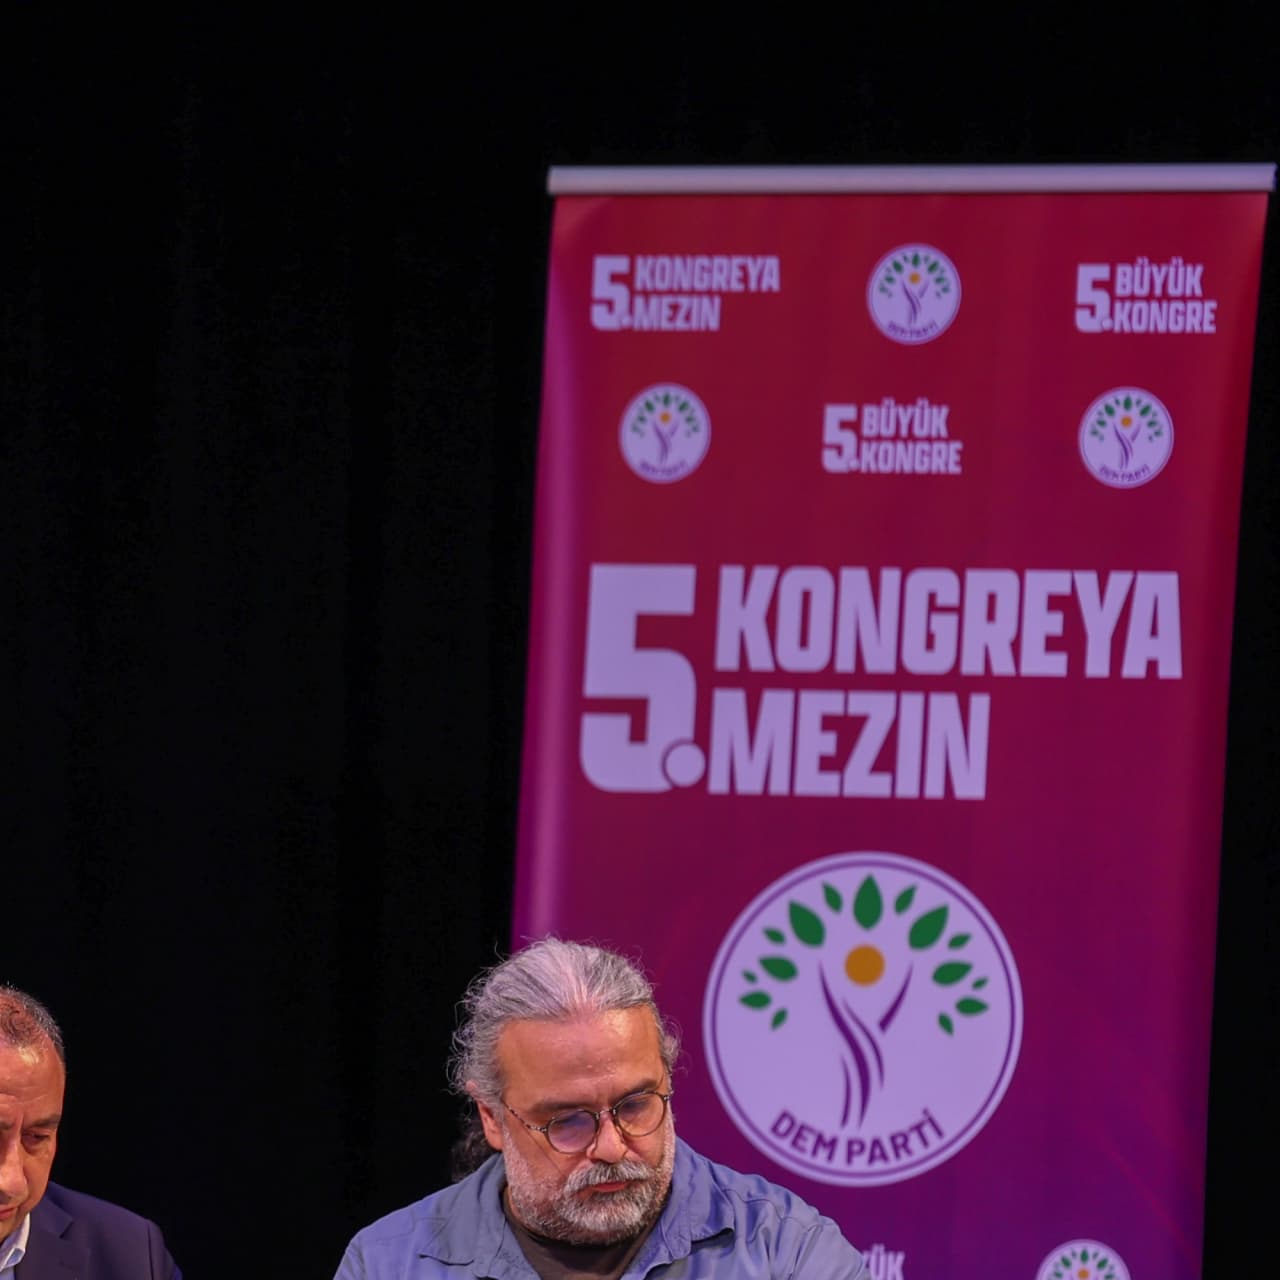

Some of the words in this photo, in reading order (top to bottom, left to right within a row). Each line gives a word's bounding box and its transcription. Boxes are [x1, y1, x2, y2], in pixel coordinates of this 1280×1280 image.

[591, 256, 633, 331] 5.
[634, 256, 780, 292] KONGREYA
[633, 295, 720, 331] MEZIN
[1076, 264, 1114, 333] 5.
[1115, 258, 1203, 297] BÜYÜK
[1114, 300, 1217, 333] KONGRE
[822, 405, 860, 473] 5.
[861, 399, 949, 438] BÜYÜK
[860, 441, 962, 474] KONGRE
[580, 564, 706, 793] 5.
[716, 566, 1182, 679] KONGREYA
[709, 688, 990, 801] MEZIN
[770, 1109, 838, 1164] DEM
[846, 1107, 945, 1166] PARTİ
